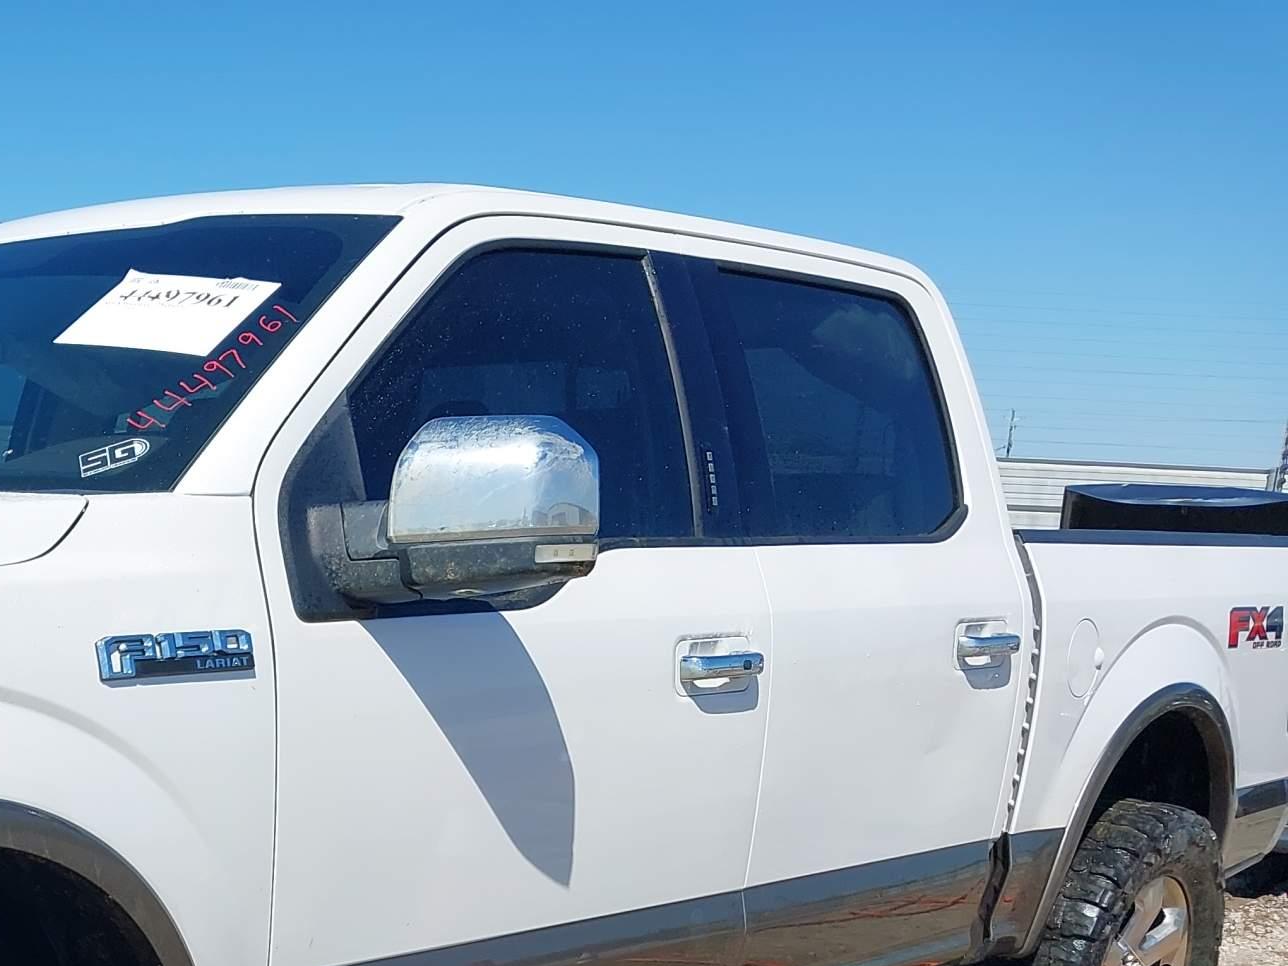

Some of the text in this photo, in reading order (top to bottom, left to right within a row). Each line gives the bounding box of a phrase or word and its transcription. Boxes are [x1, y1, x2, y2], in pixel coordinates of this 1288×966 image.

[126, 304, 298, 430] 44497961
[1227, 605, 1284, 649] FX4
[196, 655, 250, 670] LARIAT
